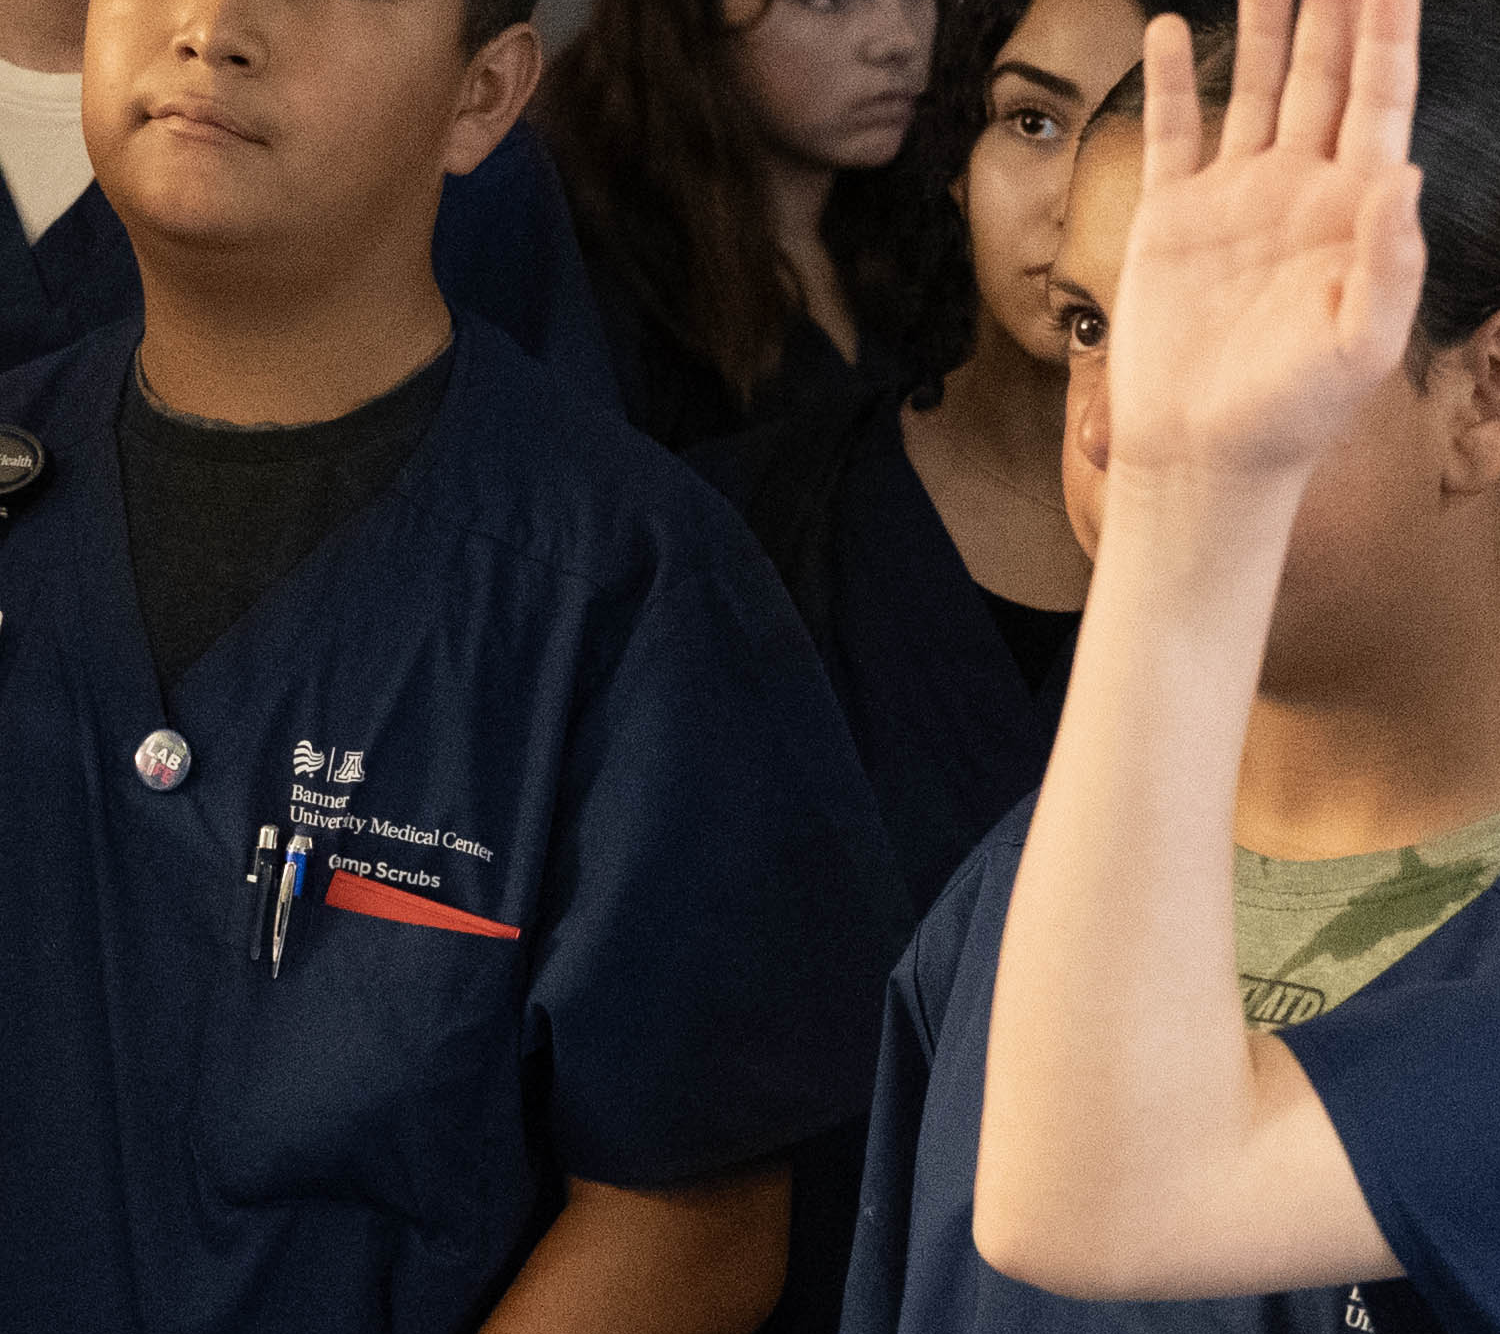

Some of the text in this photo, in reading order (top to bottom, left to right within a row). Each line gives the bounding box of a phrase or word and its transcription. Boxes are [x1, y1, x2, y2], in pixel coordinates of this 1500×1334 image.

[146, 741, 182, 770] LAB
[291, 784, 350, 809] Banner
[289, 805, 494, 862] Univerity Medical Center
[375, 861, 441, 888] Scrubs
